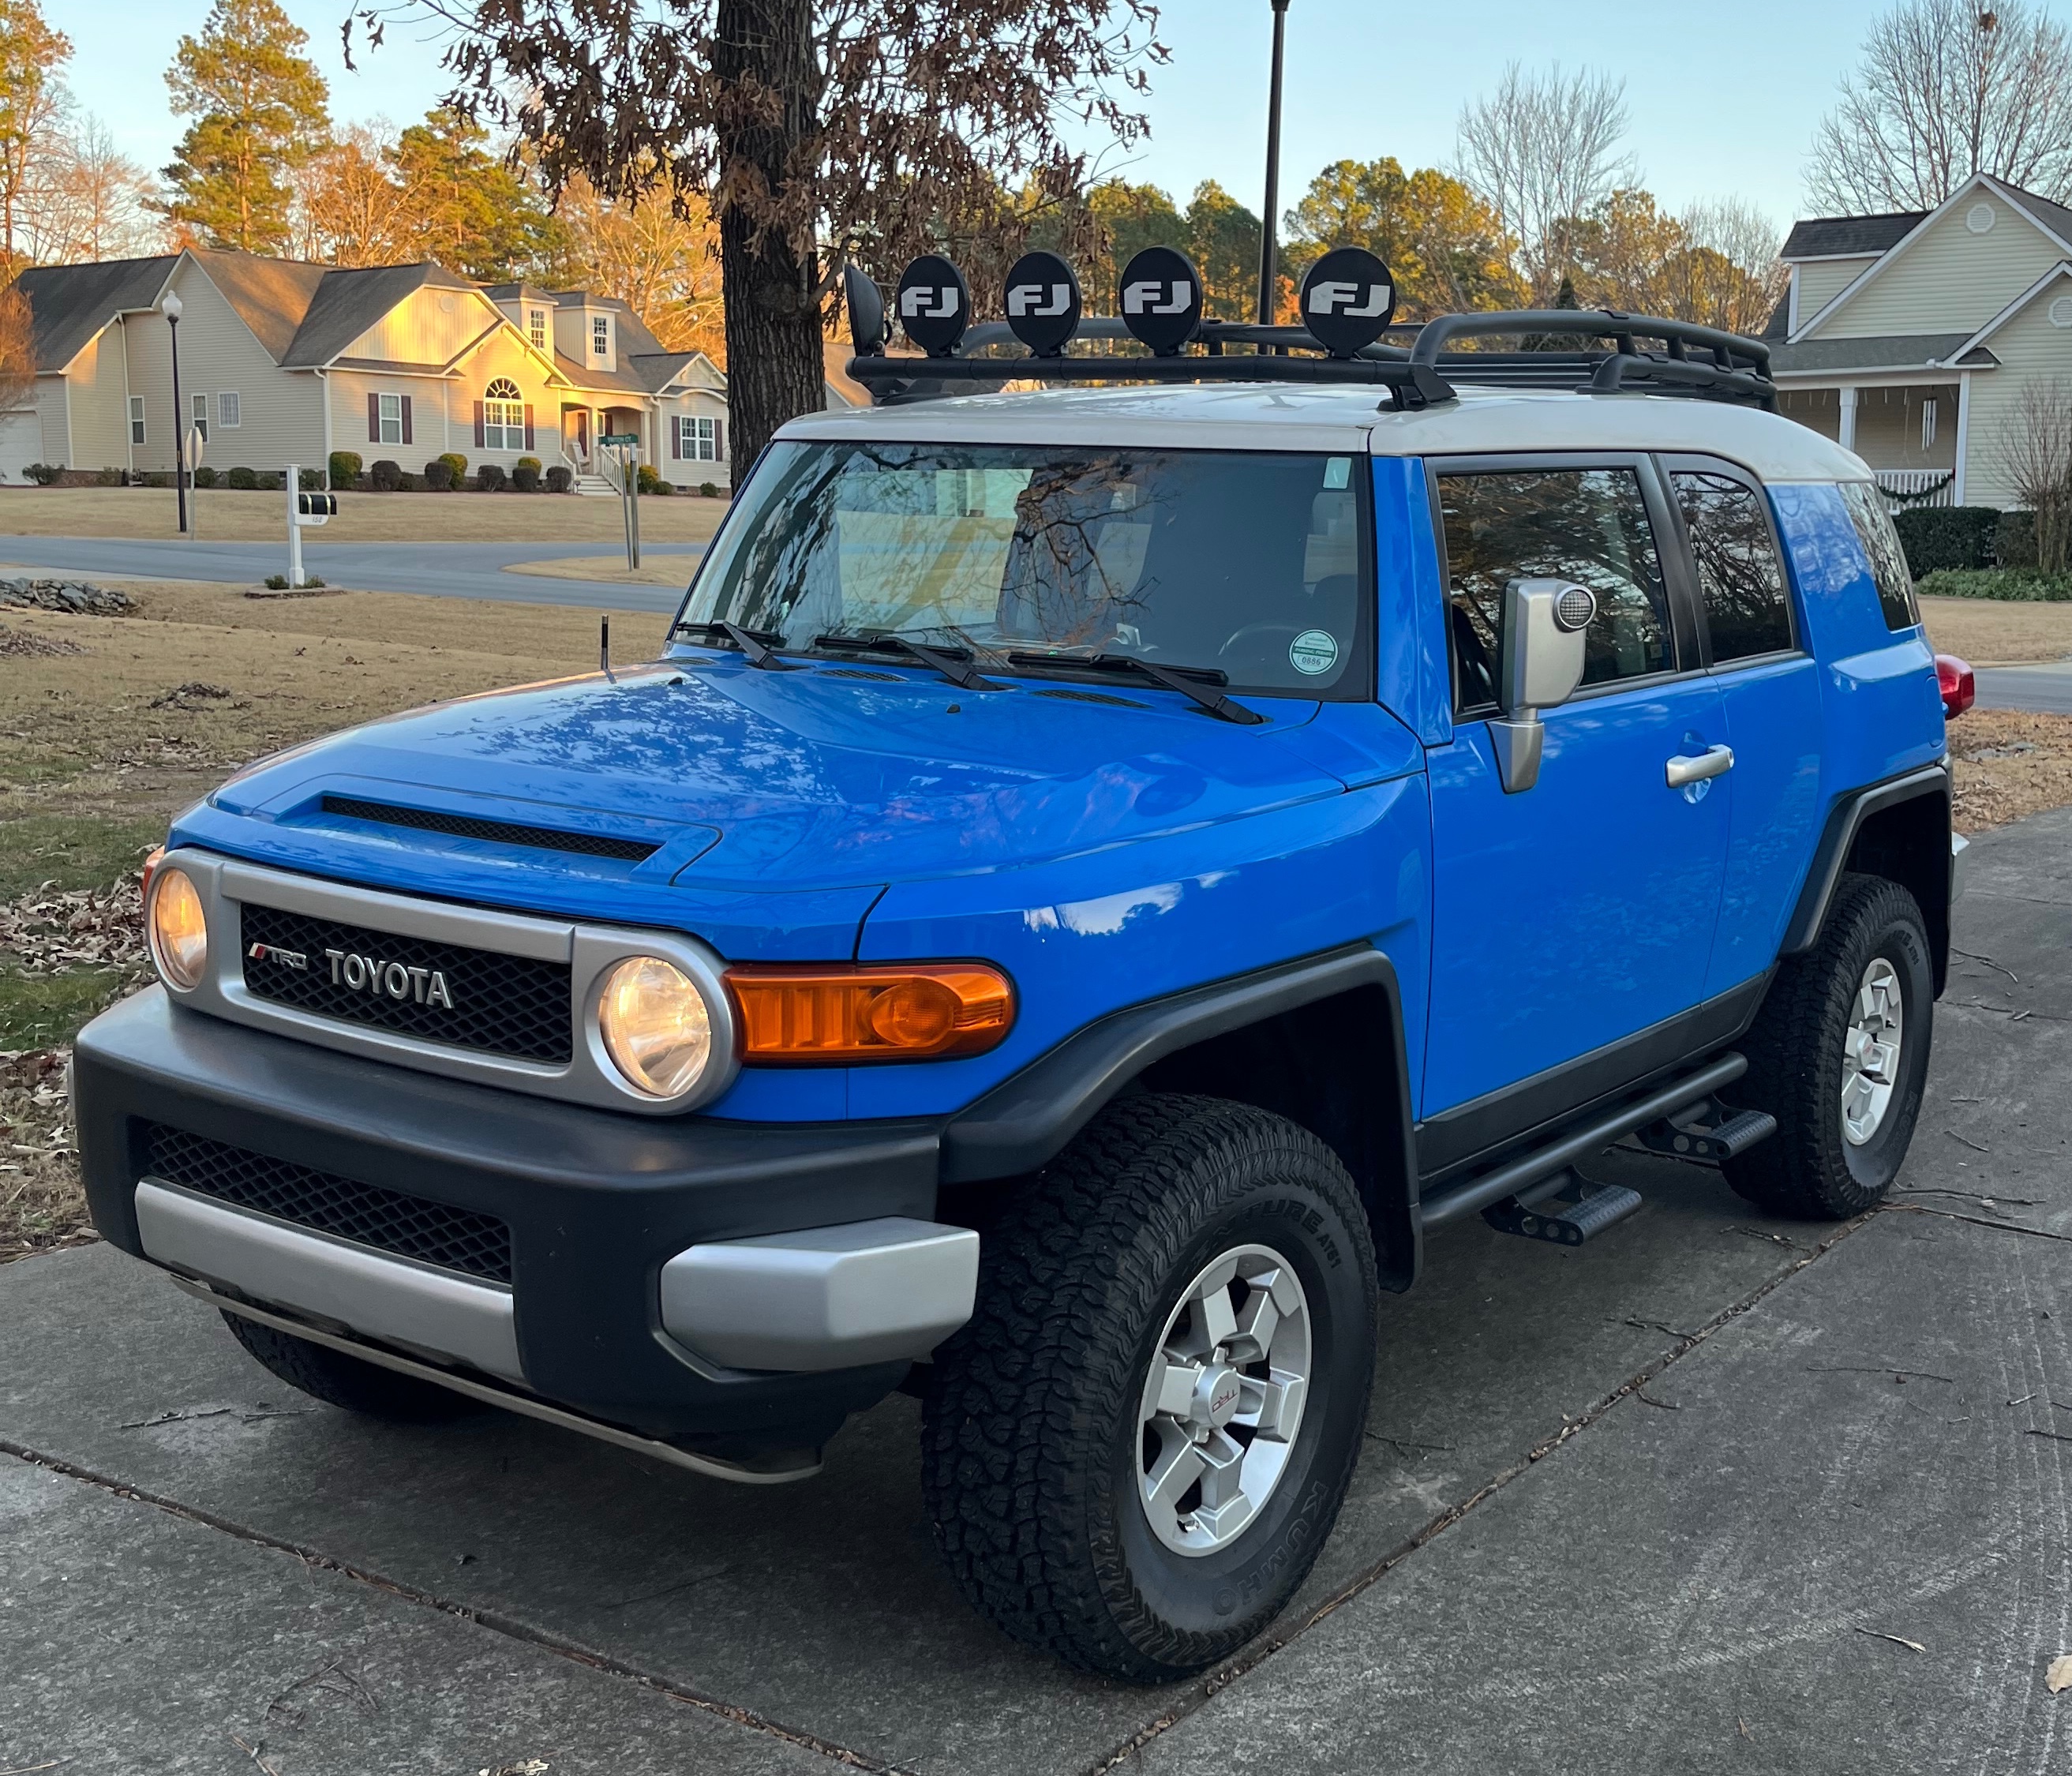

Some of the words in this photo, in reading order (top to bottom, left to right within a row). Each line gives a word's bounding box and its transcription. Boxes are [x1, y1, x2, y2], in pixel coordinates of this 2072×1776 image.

[901, 286, 959, 317] FJ
[1007, 283, 1069, 316] FJ
[1123, 280, 1192, 314] FJ
[1309, 281, 1391, 317] FJ
[268, 947, 307, 970] TRD
[325, 949, 455, 1009] TOYOTA
[1212, 1389, 1238, 1413] TRD
[1212, 1480, 1329, 1616] KUMHO
